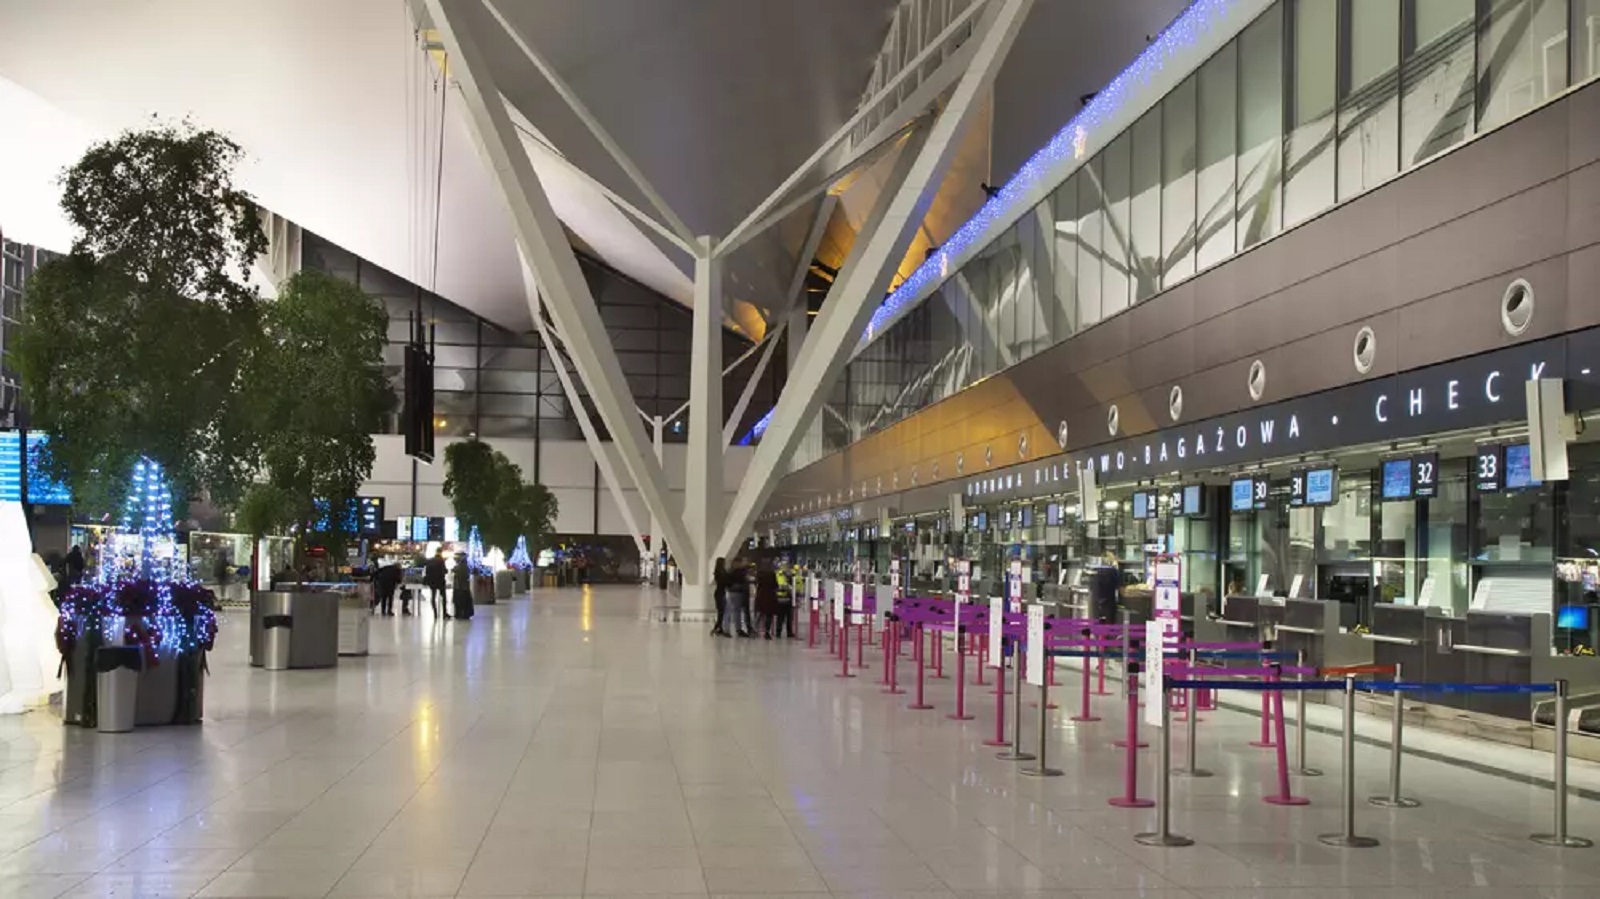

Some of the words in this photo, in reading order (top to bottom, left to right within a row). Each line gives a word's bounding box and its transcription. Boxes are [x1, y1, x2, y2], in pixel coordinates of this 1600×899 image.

[1417, 462, 1433, 484] 32
[1478, 454, 1497, 478] 33
[1255, 481, 1267, 499] 30
[1292, 477, 1302, 495] 31
